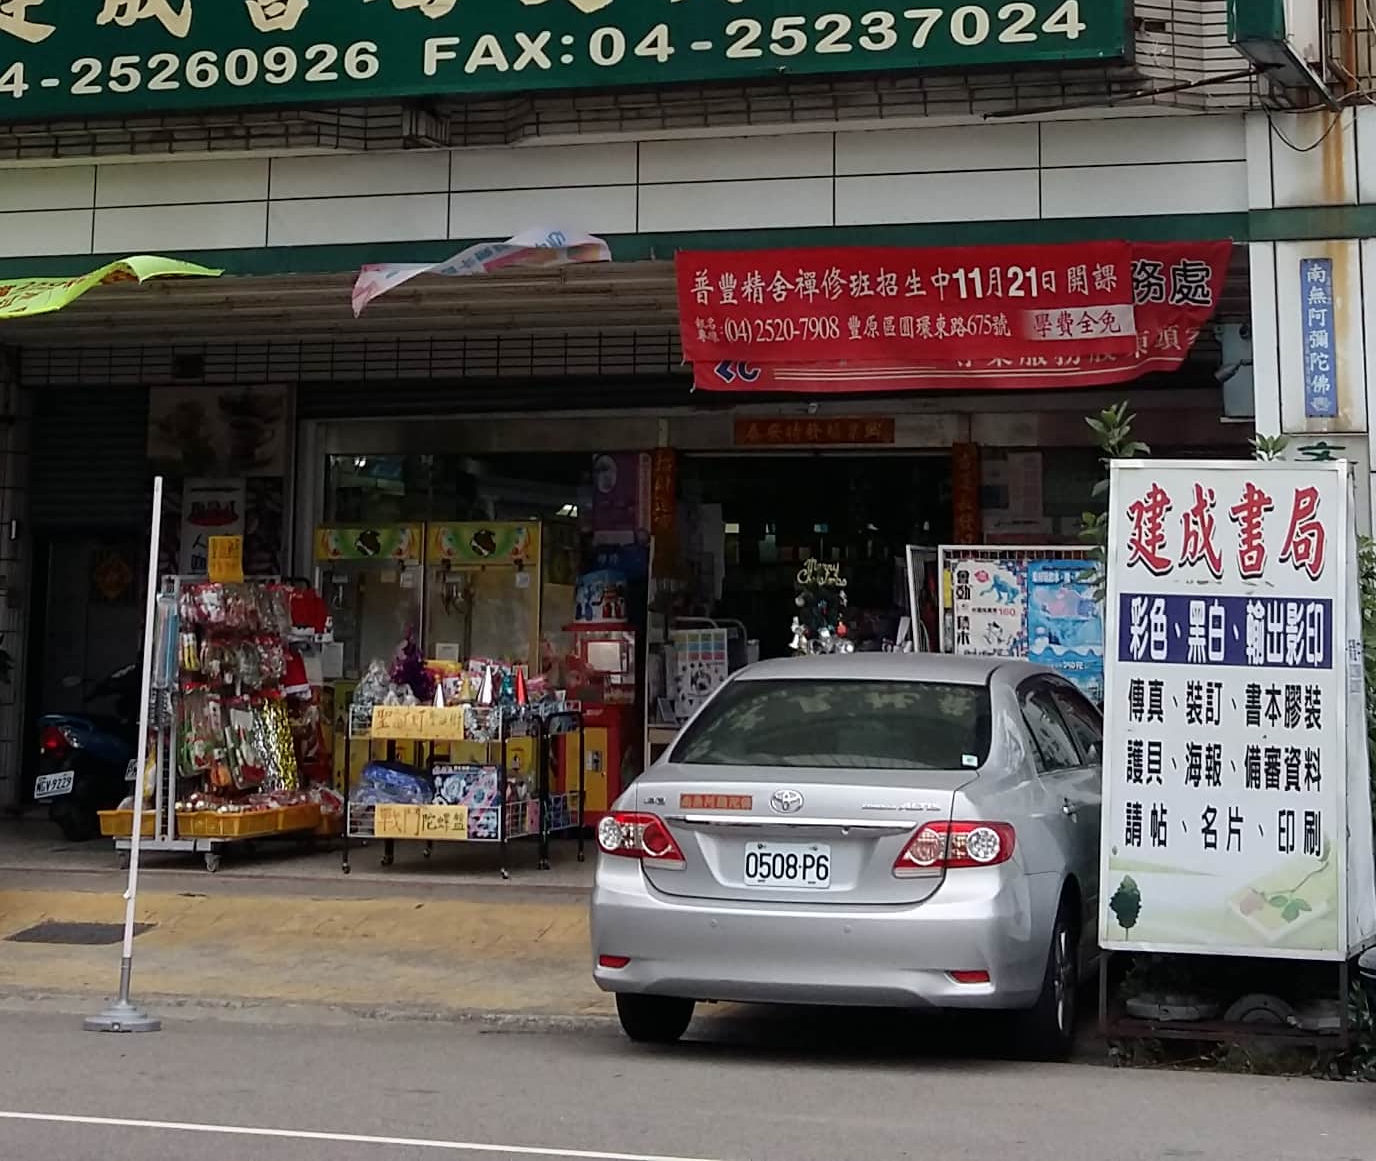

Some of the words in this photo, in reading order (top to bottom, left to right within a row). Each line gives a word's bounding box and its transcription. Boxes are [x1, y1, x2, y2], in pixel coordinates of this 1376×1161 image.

[1033, 308, 1122, 338] 學費全免
[1306, 263, 1332, 394] 南無阿彌陀佛
[1125, 482, 1329, 581] 建成書局
